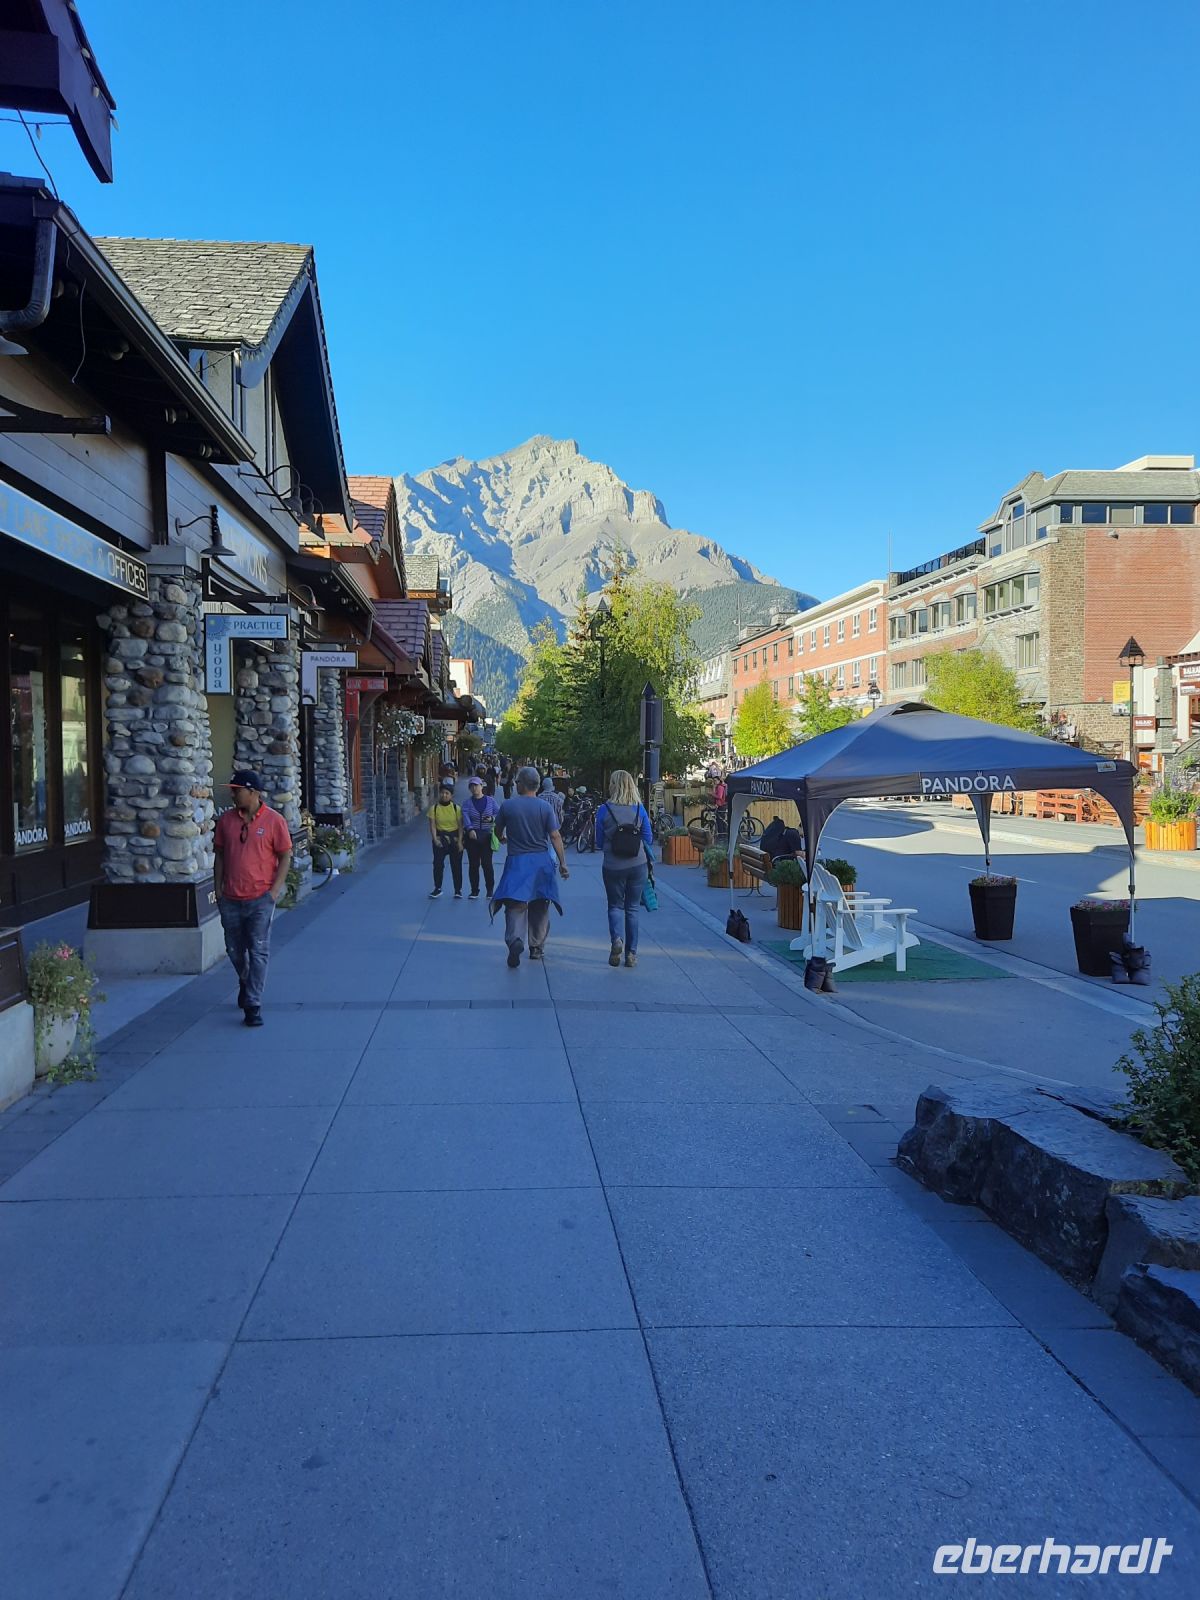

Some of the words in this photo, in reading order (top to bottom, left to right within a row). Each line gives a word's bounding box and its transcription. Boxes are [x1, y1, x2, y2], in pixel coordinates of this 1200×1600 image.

[107, 551, 146, 592] OFFICES
[233, 620, 282, 631] PRACTICE
[213, 643, 222, 689] yoga
[310, 655, 346, 663] PANDORA
[751, 780, 774, 795] PANDORA
[922, 775, 1016, 793] PANDORA
